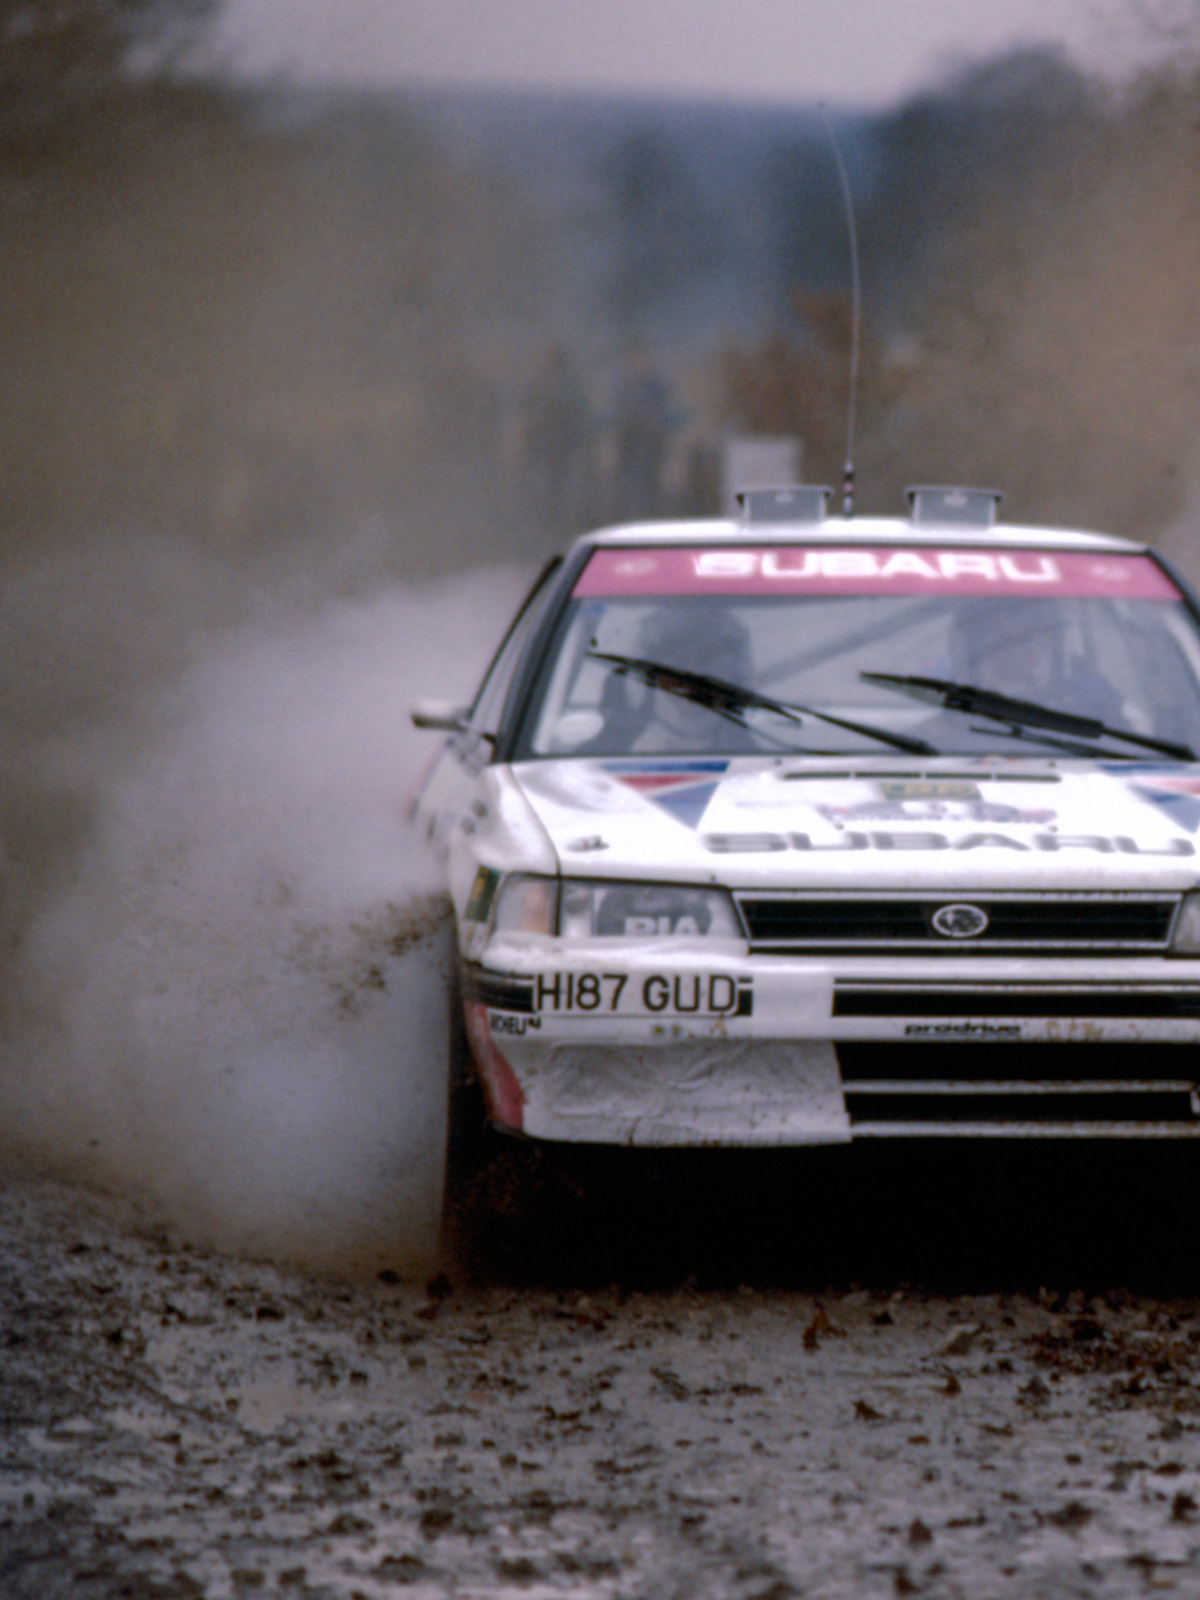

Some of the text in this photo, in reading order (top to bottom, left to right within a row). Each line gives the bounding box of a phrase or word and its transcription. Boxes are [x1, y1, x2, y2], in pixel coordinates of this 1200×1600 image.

[694, 550, 1061, 582] SUBARU
[703, 829, 1197, 857] SUBARU
[533, 972, 739, 1013] H187 GUD
[904, 1021, 1023, 1037] prodrive
